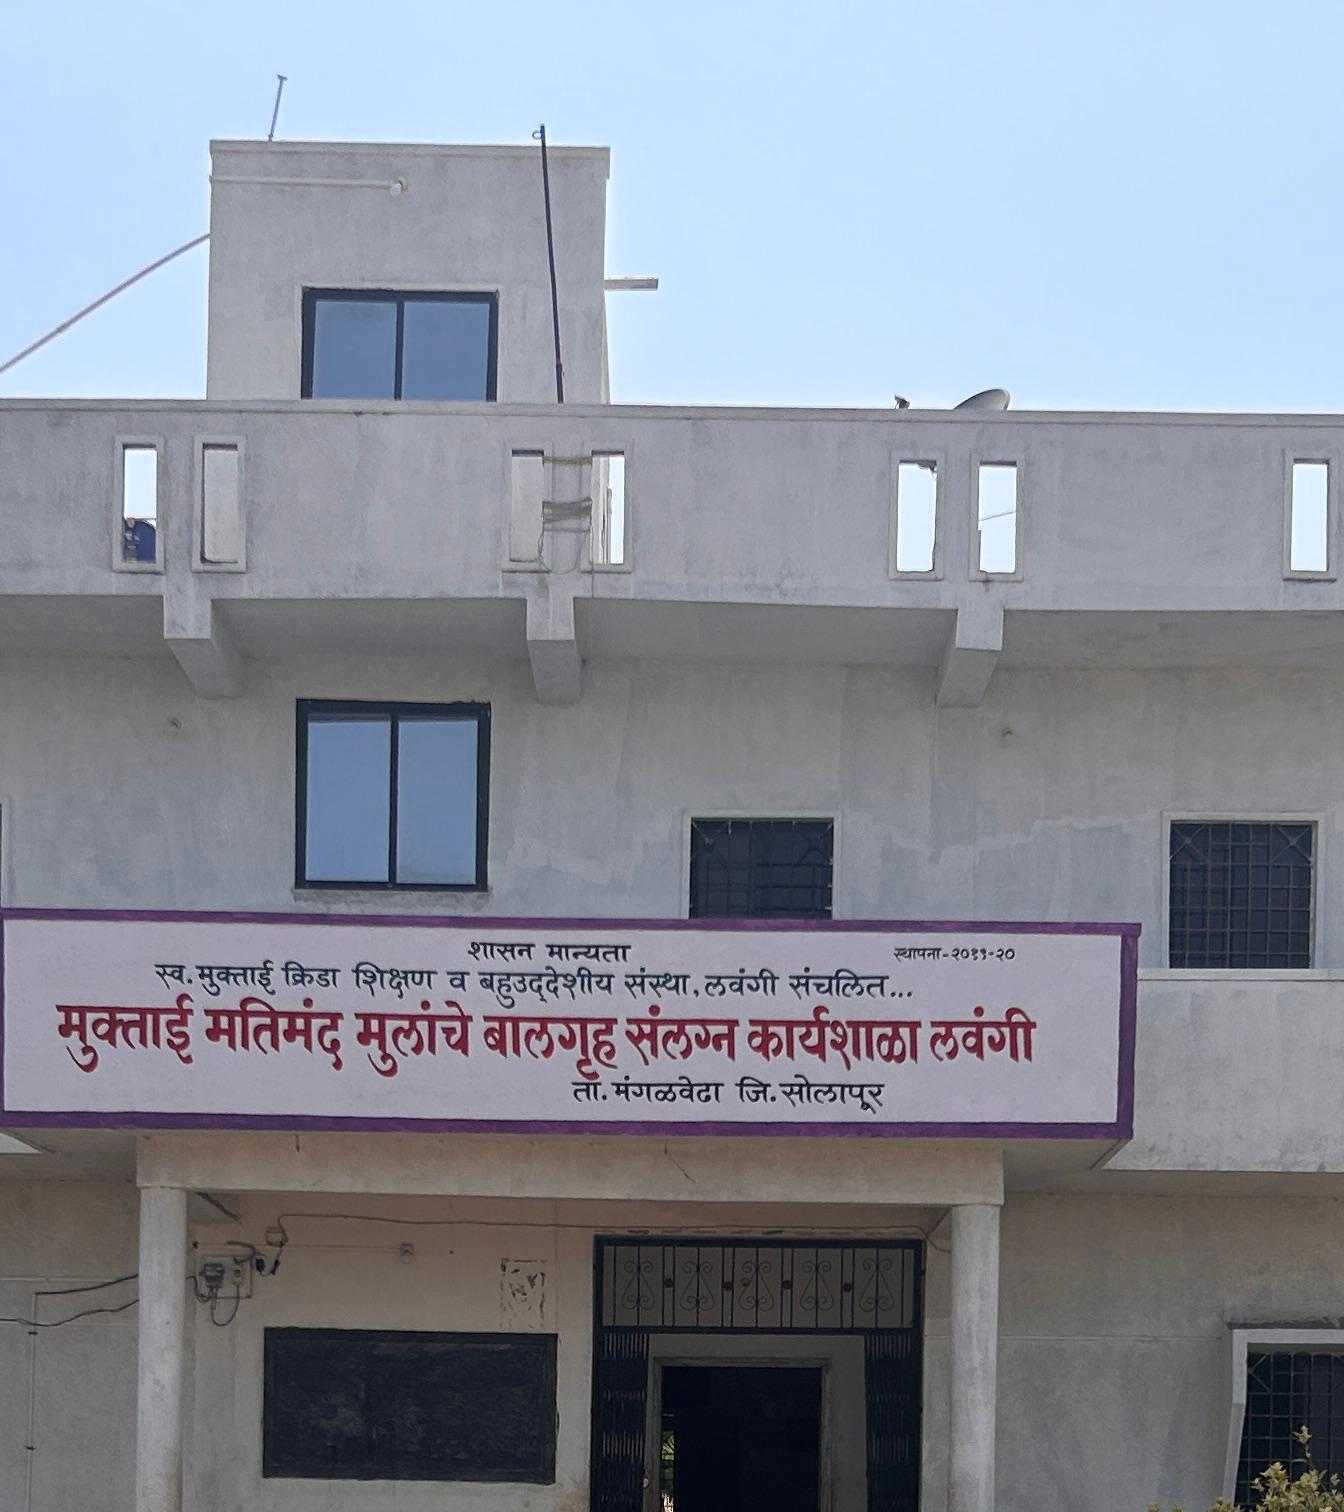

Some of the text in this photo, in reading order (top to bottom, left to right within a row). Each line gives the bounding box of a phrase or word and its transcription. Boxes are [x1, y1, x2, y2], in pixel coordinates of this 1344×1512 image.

[467, 941, 632, 963] शासन मान्यता
[281, 960, 342, 989] क्रिडा
[352, 961, 439, 1000] शिक्षण
[446, 970, 471, 993] व
[56, 993, 1037, 1081] मुक्ताई मतिमंद मुलांचे बालगृह संलग्न कार्यशाळा लवंगी
